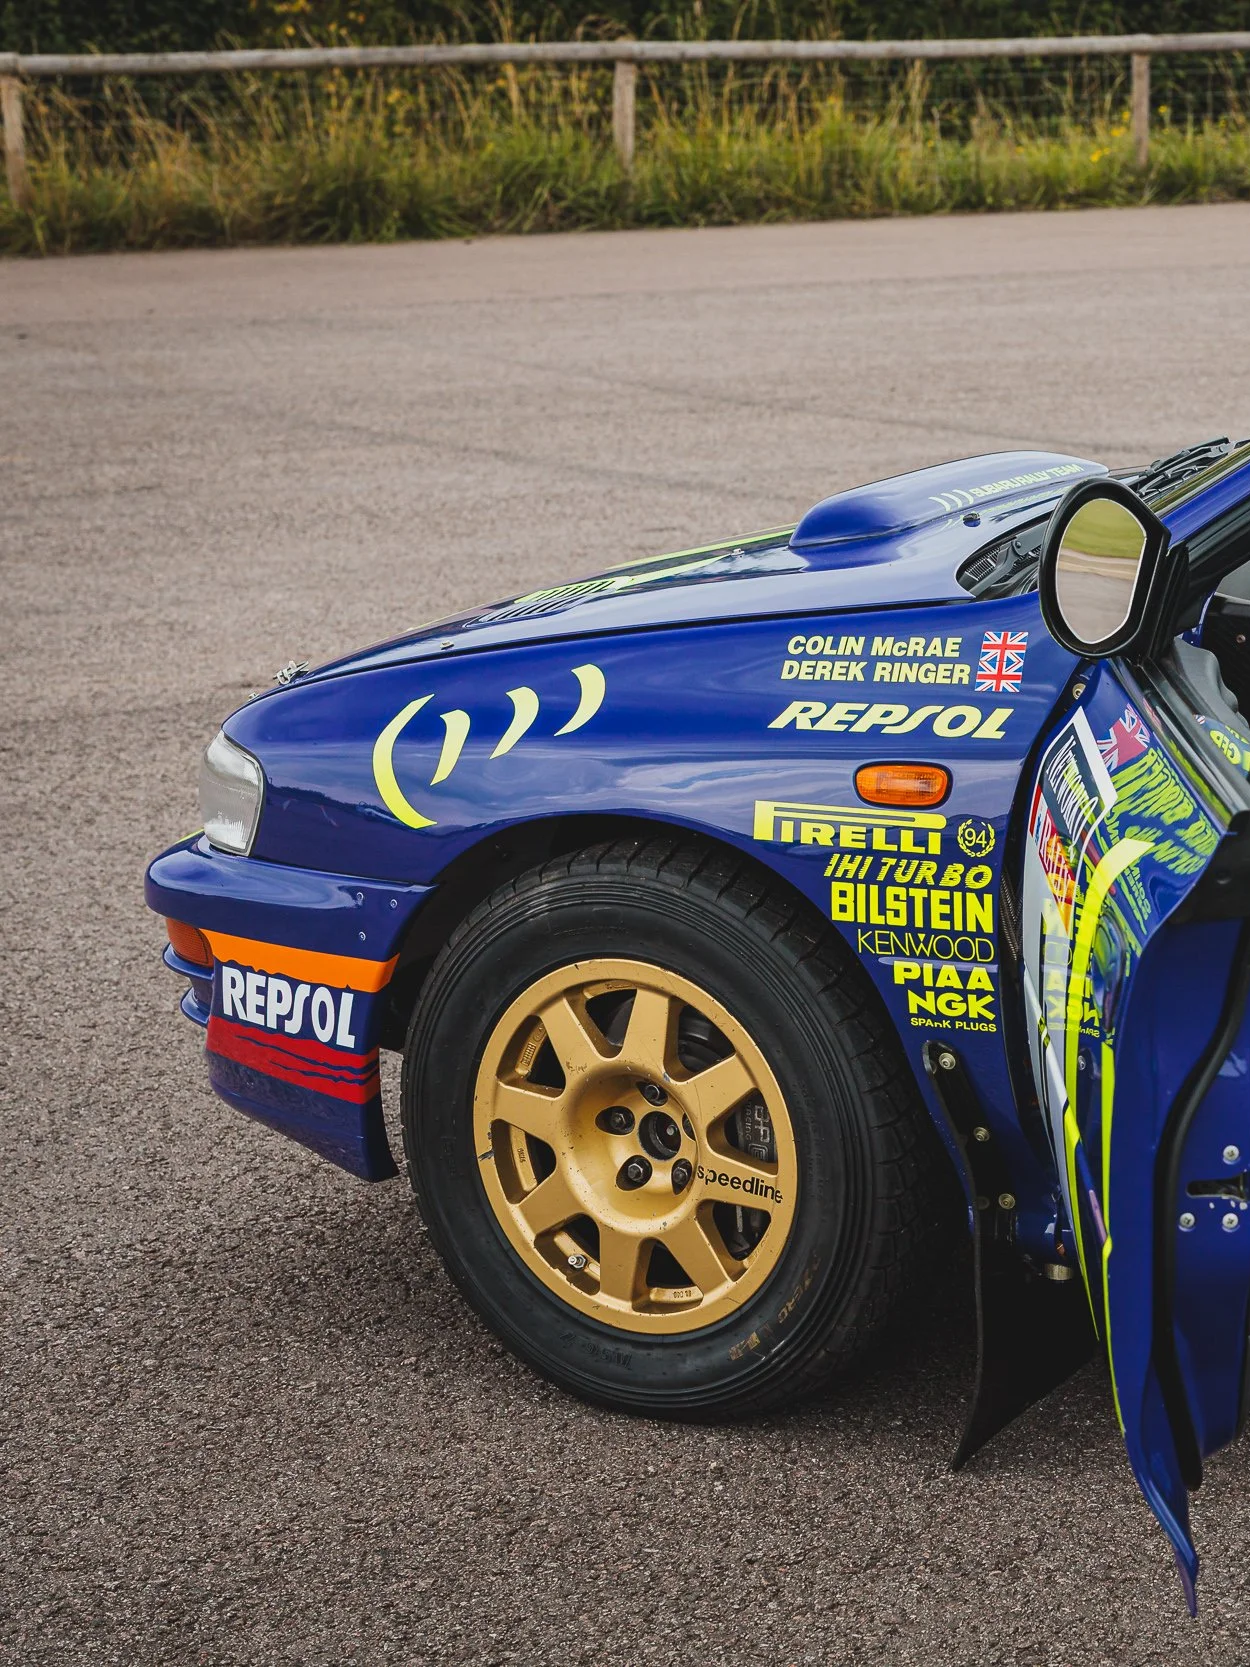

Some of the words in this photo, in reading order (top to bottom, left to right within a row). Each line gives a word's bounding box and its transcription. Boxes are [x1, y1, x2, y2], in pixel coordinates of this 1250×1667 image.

[787, 635, 865, 656] COLIN
[870, 636, 962, 658] McRAE
[781, 660, 868, 682] DEREK
[873, 662, 971, 685] RINGER
[767, 700, 1014, 740] REPSOL
[753, 800, 947, 855] PIRELLI
[964, 827, 988, 848] 94
[823, 853, 873, 879] IHI
[876, 857, 993, 889] TURBO
[831, 881, 994, 934] BILSTEIN
[857, 929, 994, 963] KENWOOD
[893, 960, 995, 992] PIAA
[222, 965, 356, 1049] REPSOL
[907, 989, 996, 1021] NGK
[955, 1020, 997, 1033] PLUGS
[697, 1165, 784, 1204] speedline
